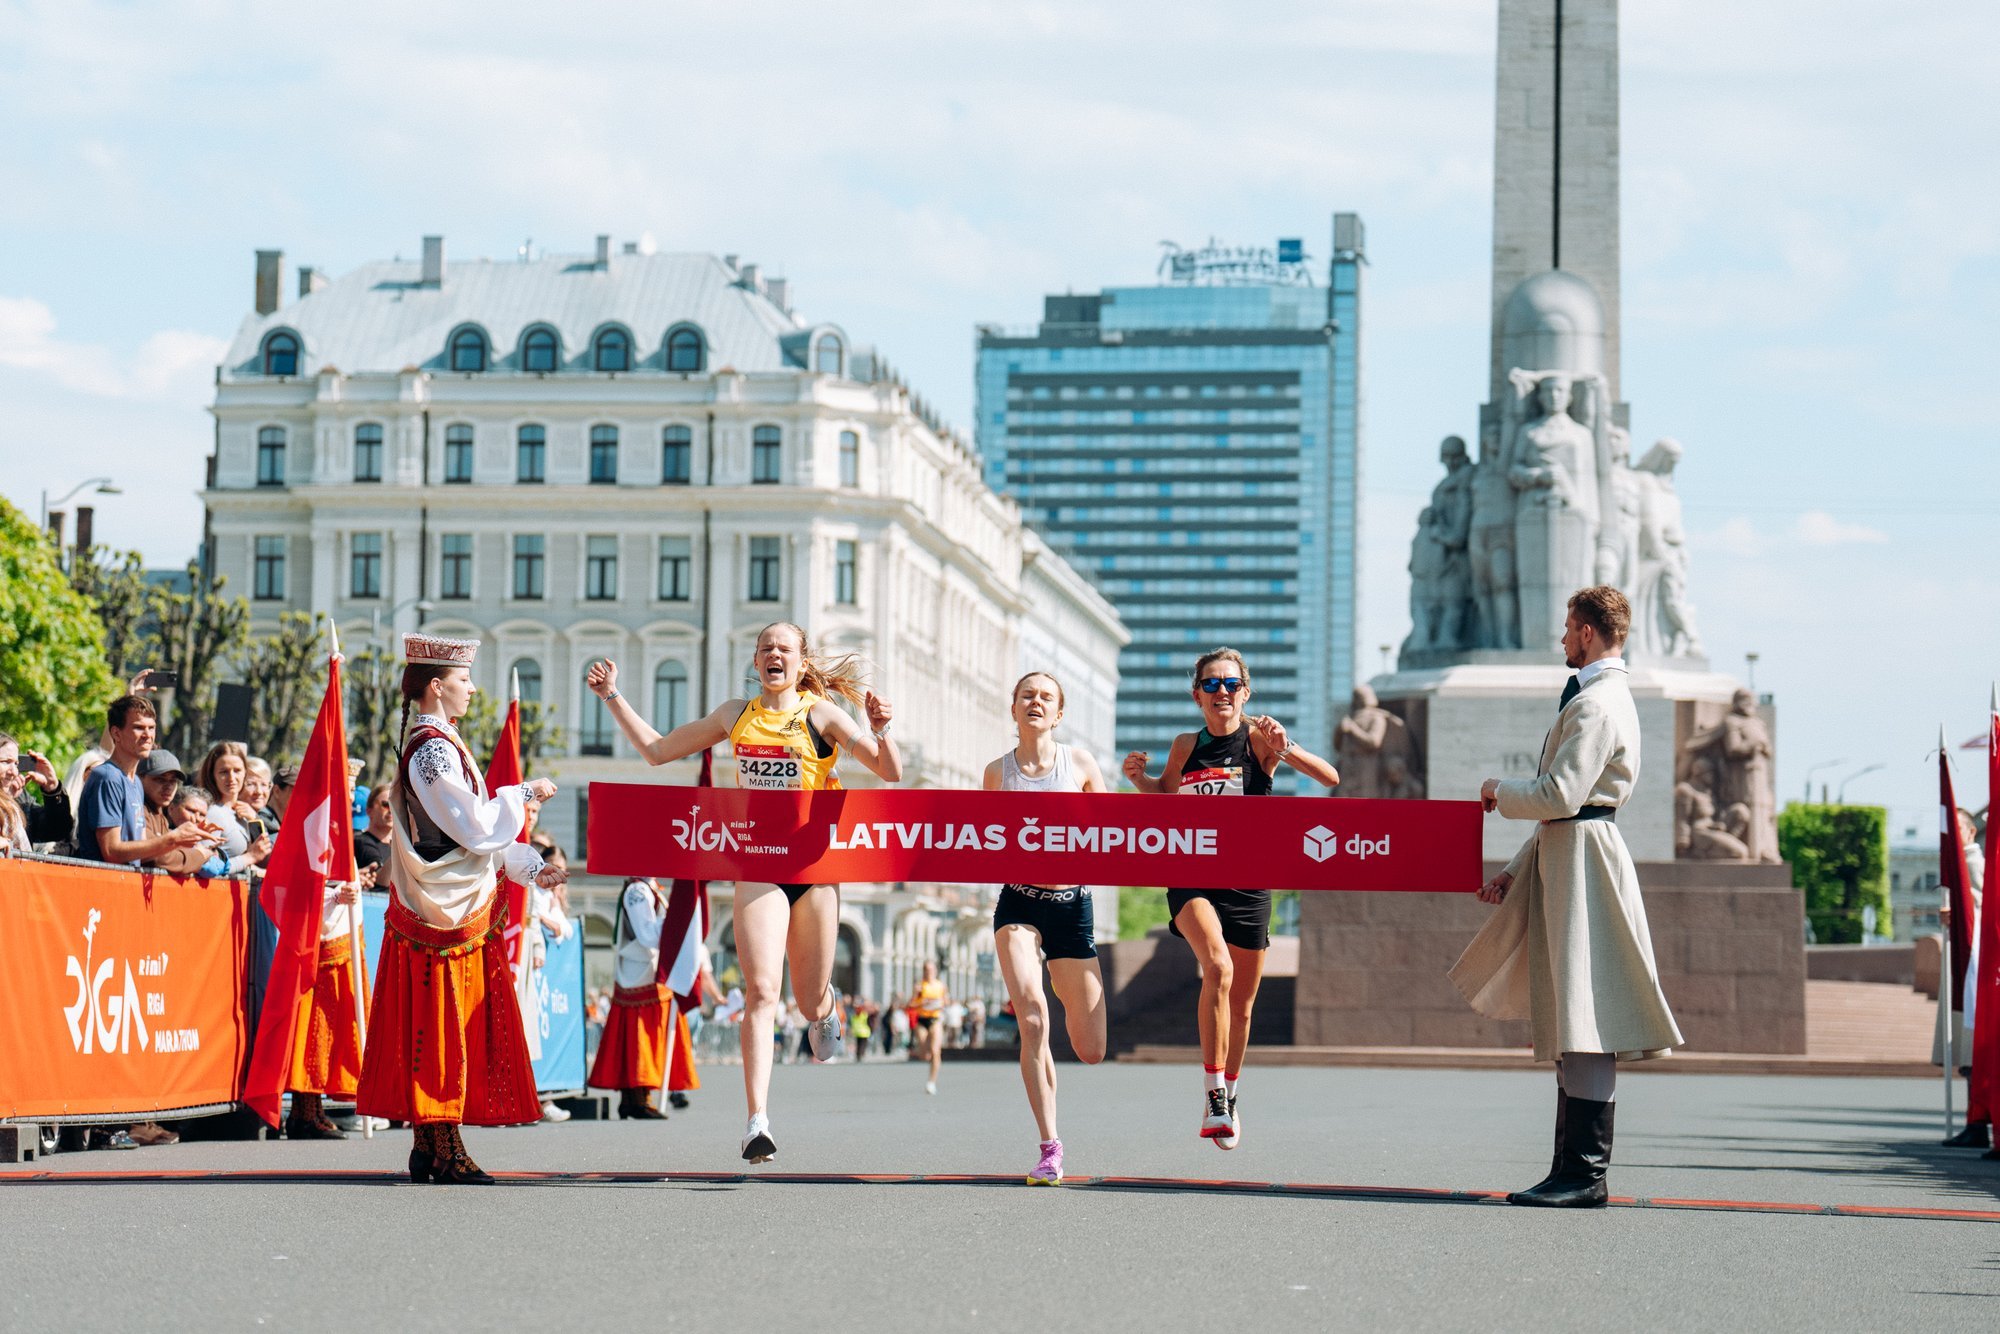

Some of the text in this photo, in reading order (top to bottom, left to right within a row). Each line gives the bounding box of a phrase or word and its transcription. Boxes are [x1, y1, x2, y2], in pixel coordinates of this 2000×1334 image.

[740, 759, 798, 777] 34228
[749, 778, 785, 788] MARTA
[1193, 781, 1226, 795] 107
[737, 833, 752, 841] RIGA
[829, 817, 1218, 855] LATVIJAS ČEMPIONE
[745, 845, 788, 855] MARATHON
[1345, 833, 1390, 860] dpd
[1039, 891, 1074, 902] PRO
[147, 992, 165, 1015] RIGA
[155, 1029, 200, 1053] MARATHON
